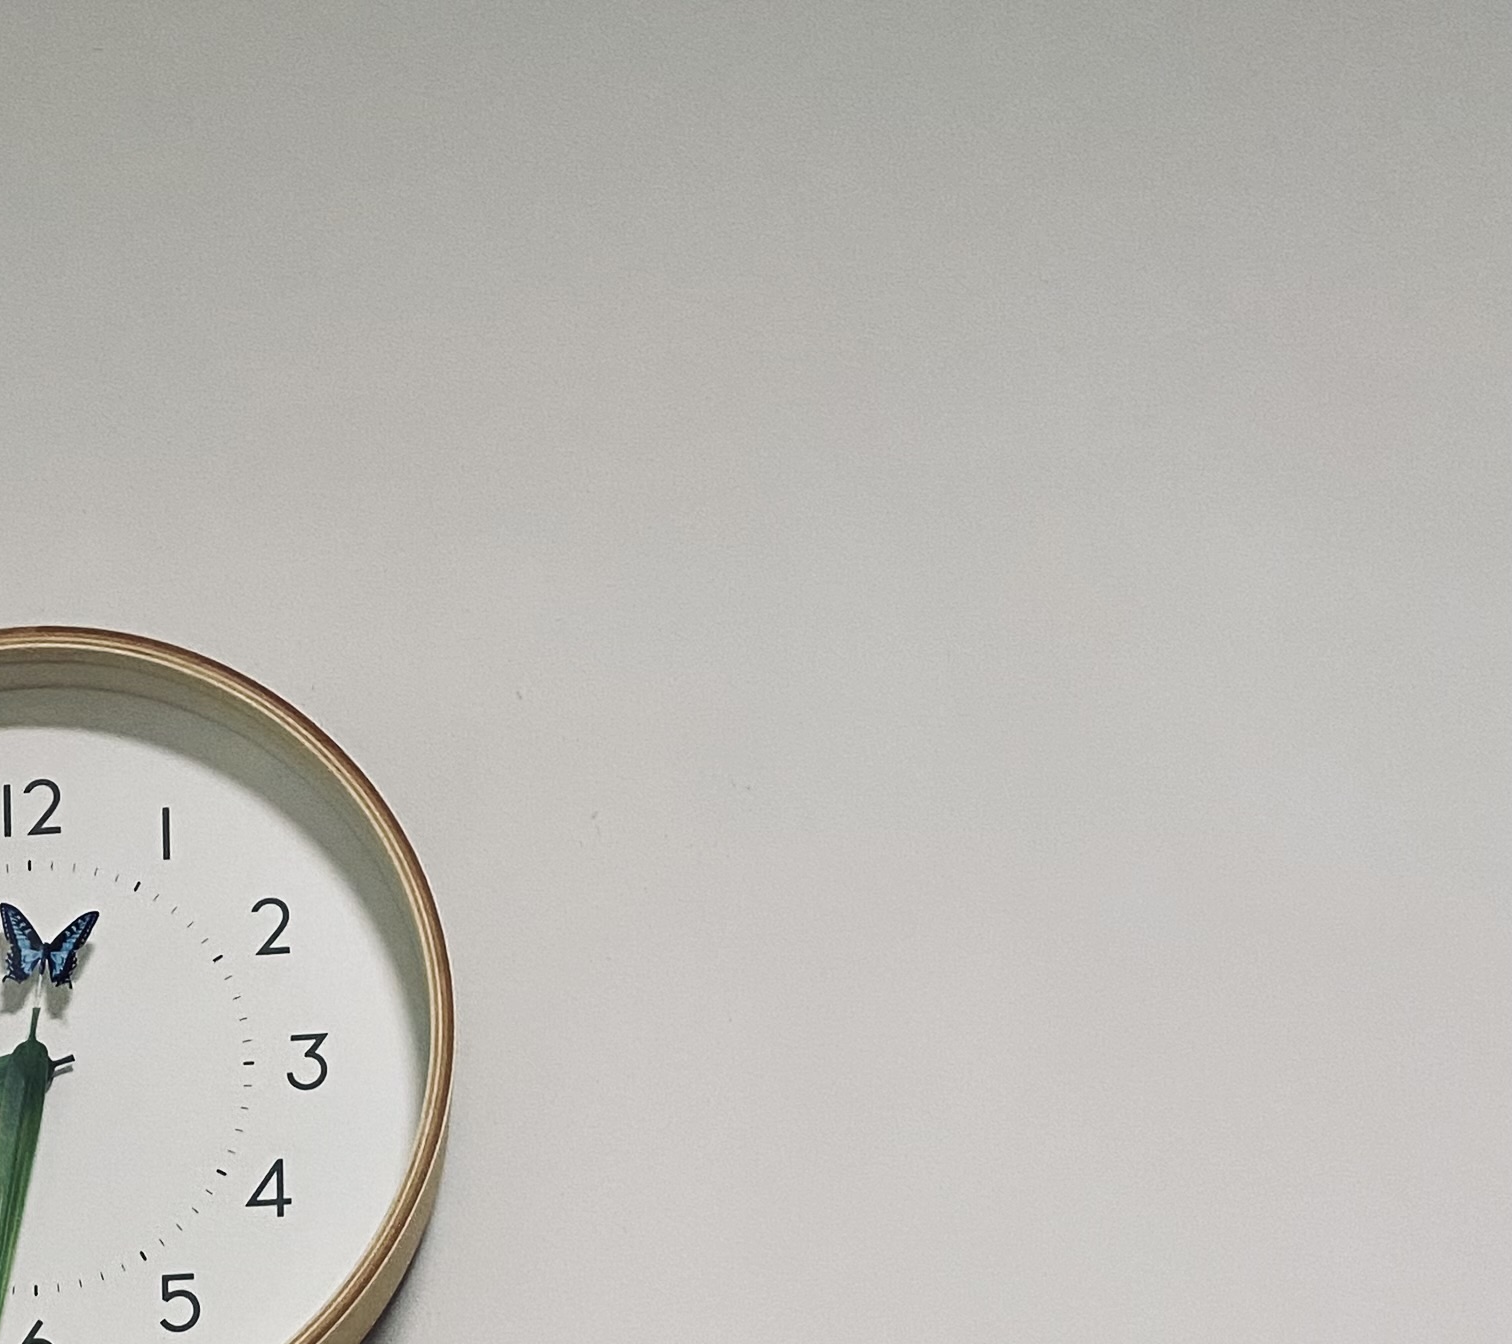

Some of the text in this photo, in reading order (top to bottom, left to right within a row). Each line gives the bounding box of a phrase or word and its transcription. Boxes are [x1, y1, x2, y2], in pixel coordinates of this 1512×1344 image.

[3, 778, 62, 838] 12
[161, 806, 171, 861] 1
[251, 897, 291, 956] 2
[286, 1032, 329, 1091] 3
[244, 1158, 293, 1218] 4
[159, 1272, 201, 1333] 5
